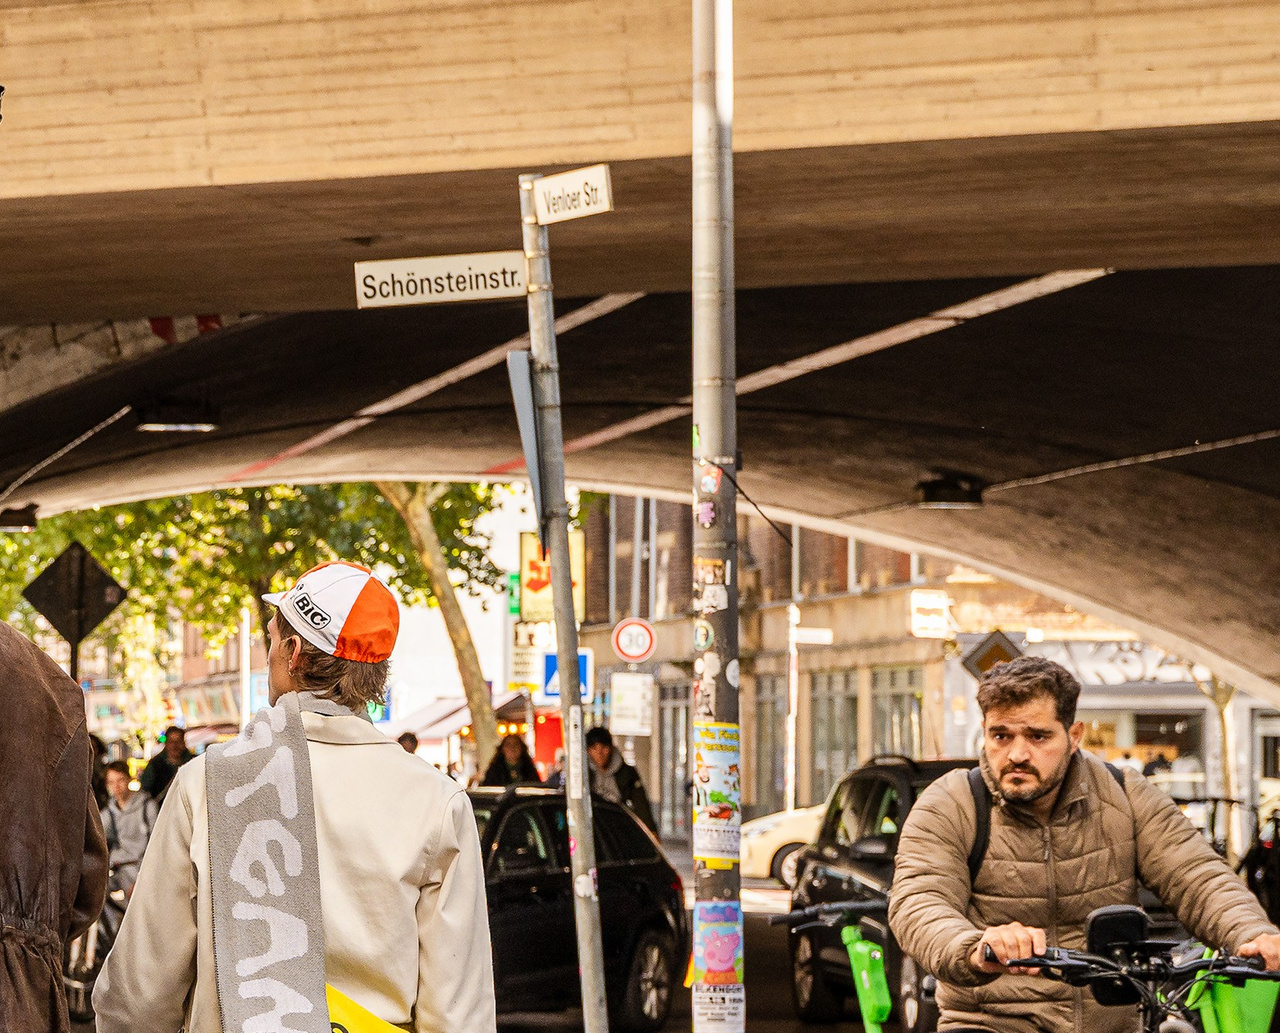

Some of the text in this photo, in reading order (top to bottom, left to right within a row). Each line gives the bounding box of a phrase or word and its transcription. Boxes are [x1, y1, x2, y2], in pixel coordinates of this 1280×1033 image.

[543, 182, 602, 215] Venloer Str.
[362, 266, 522, 299] Schönsteinstr.
[295, 595, 329, 626] BIC
